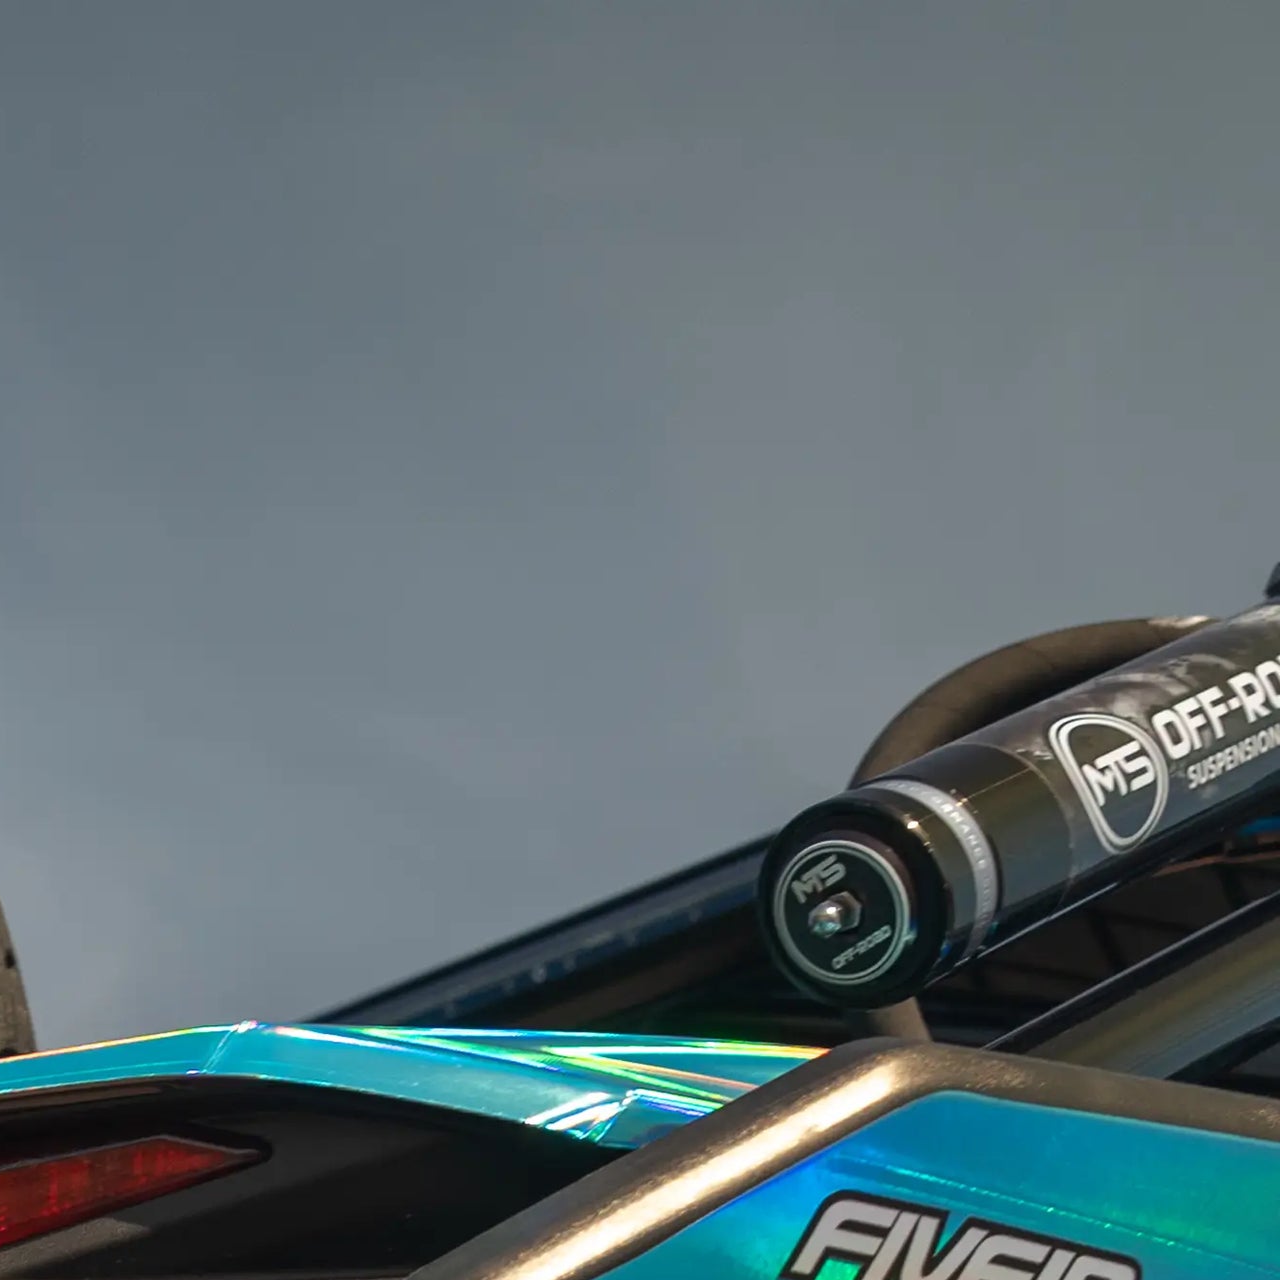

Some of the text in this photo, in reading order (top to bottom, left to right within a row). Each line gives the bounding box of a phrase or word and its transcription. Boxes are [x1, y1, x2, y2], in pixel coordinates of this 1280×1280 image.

[1151, 655, 1280, 760] OFF-RO
[1081, 740, 1156, 807] MTS
[791, 854, 846, 904] MTS
[831, 924, 890, 970] OFF-ROAD
